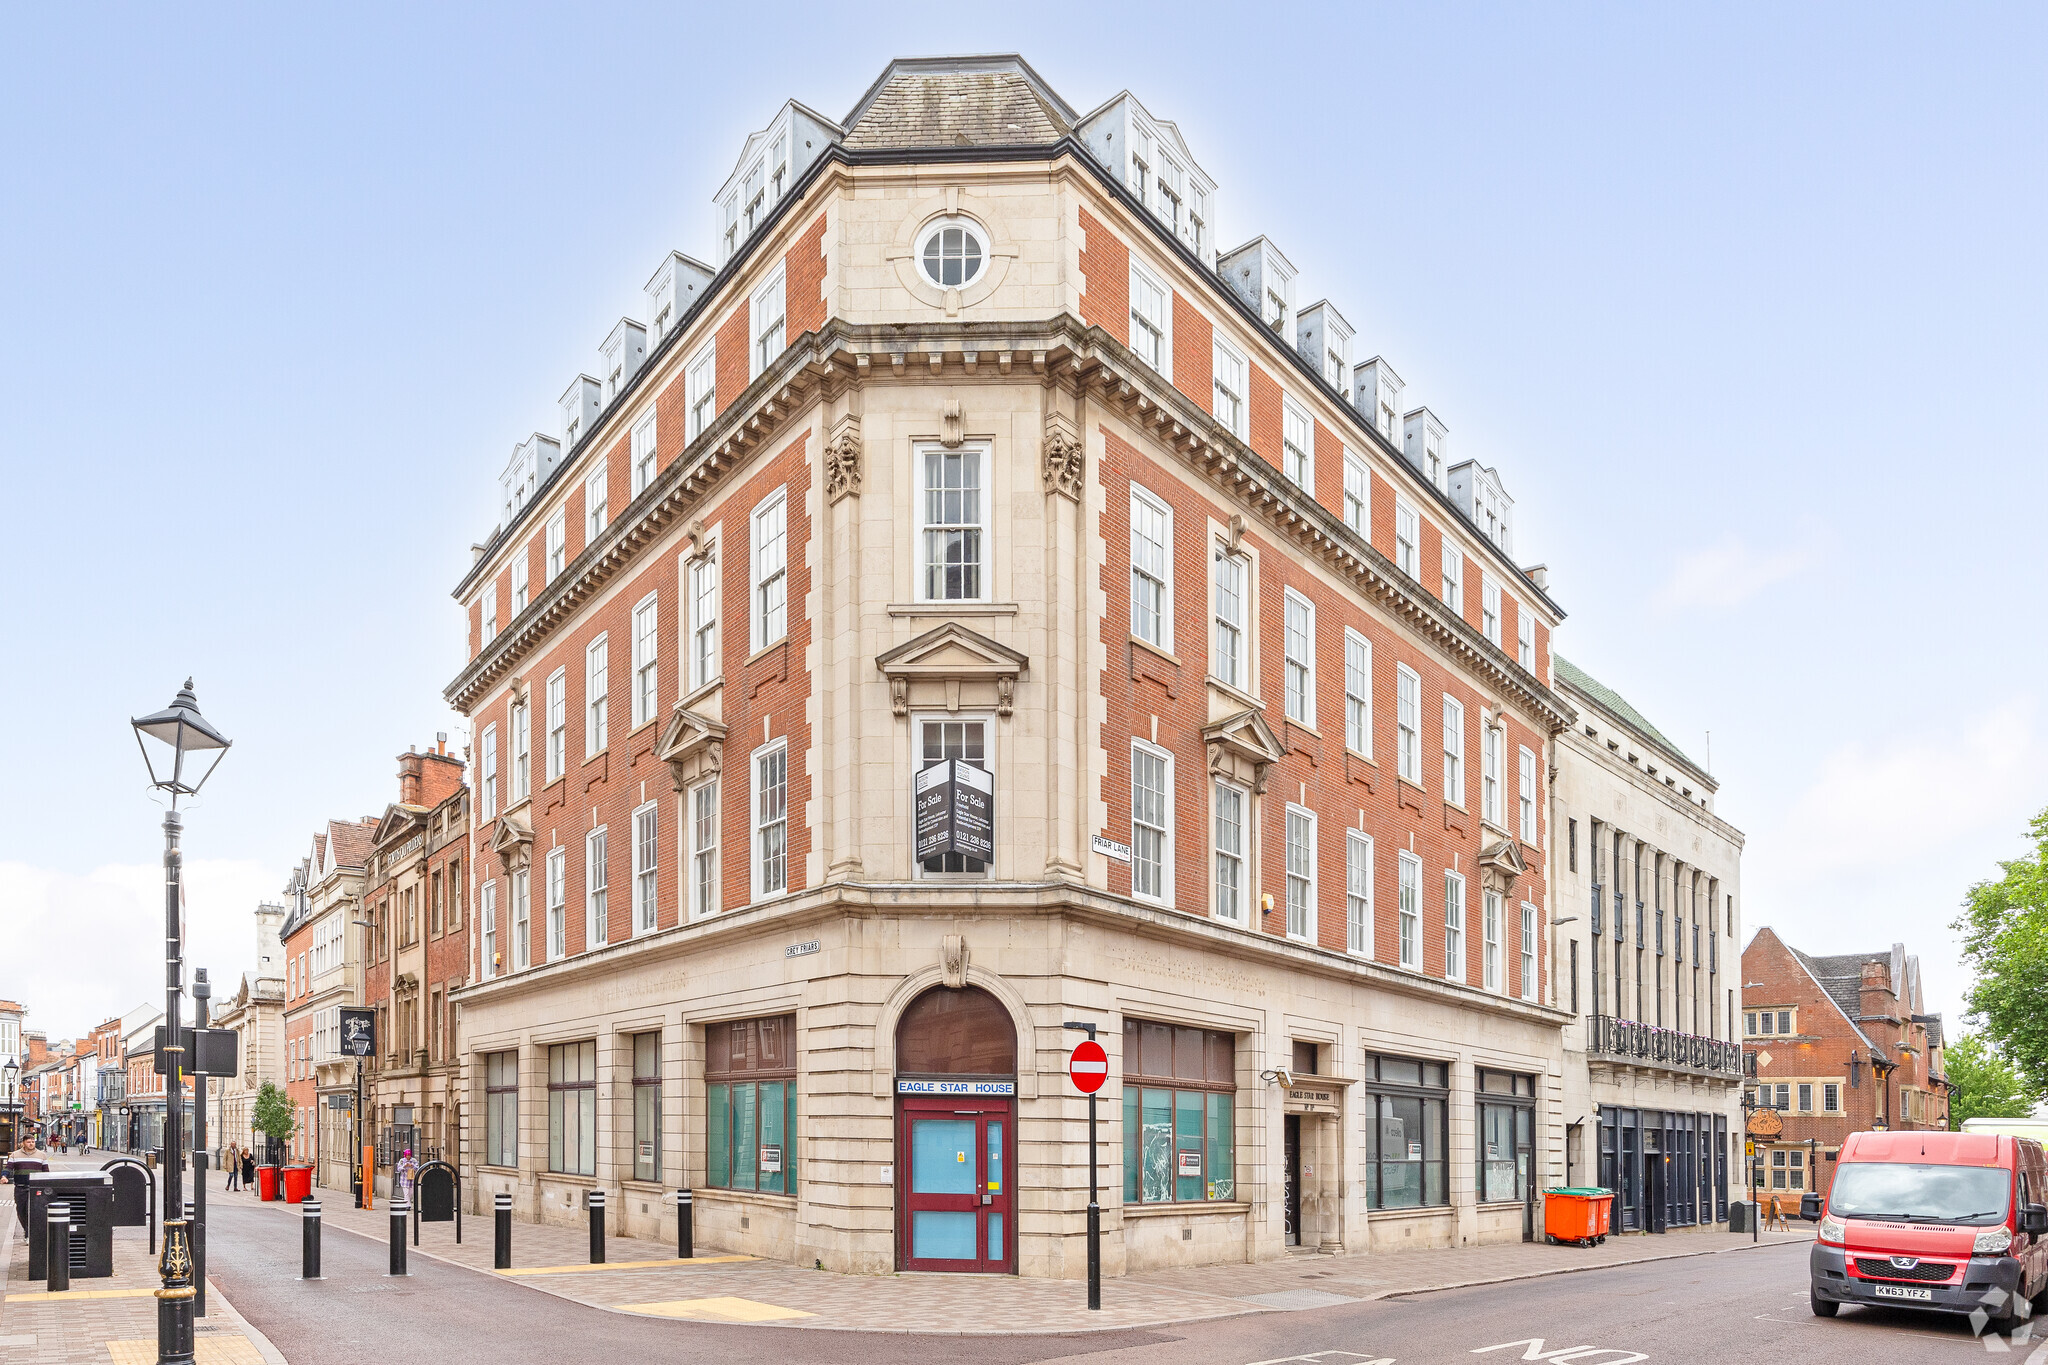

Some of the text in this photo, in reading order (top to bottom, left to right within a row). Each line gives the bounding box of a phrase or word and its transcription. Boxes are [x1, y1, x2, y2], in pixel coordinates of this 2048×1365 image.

[918, 800, 927, 811] For
[927, 793, 942, 806] Sale
[956, 789, 968, 803] For
[969, 794, 985, 809] Sale
[1094, 836, 1112, 850] FRIAR
[1113, 843, 1129, 856] LANE
[786, 942, 818, 956] GREY FRIARS
[899, 1082, 1013, 1093] EAGLE STAR HOUSE
[1289, 1090, 1330, 1101] EAGLE STAR HOUSE
[1878, 1286, 1926, 1299] KW63 YFZ
